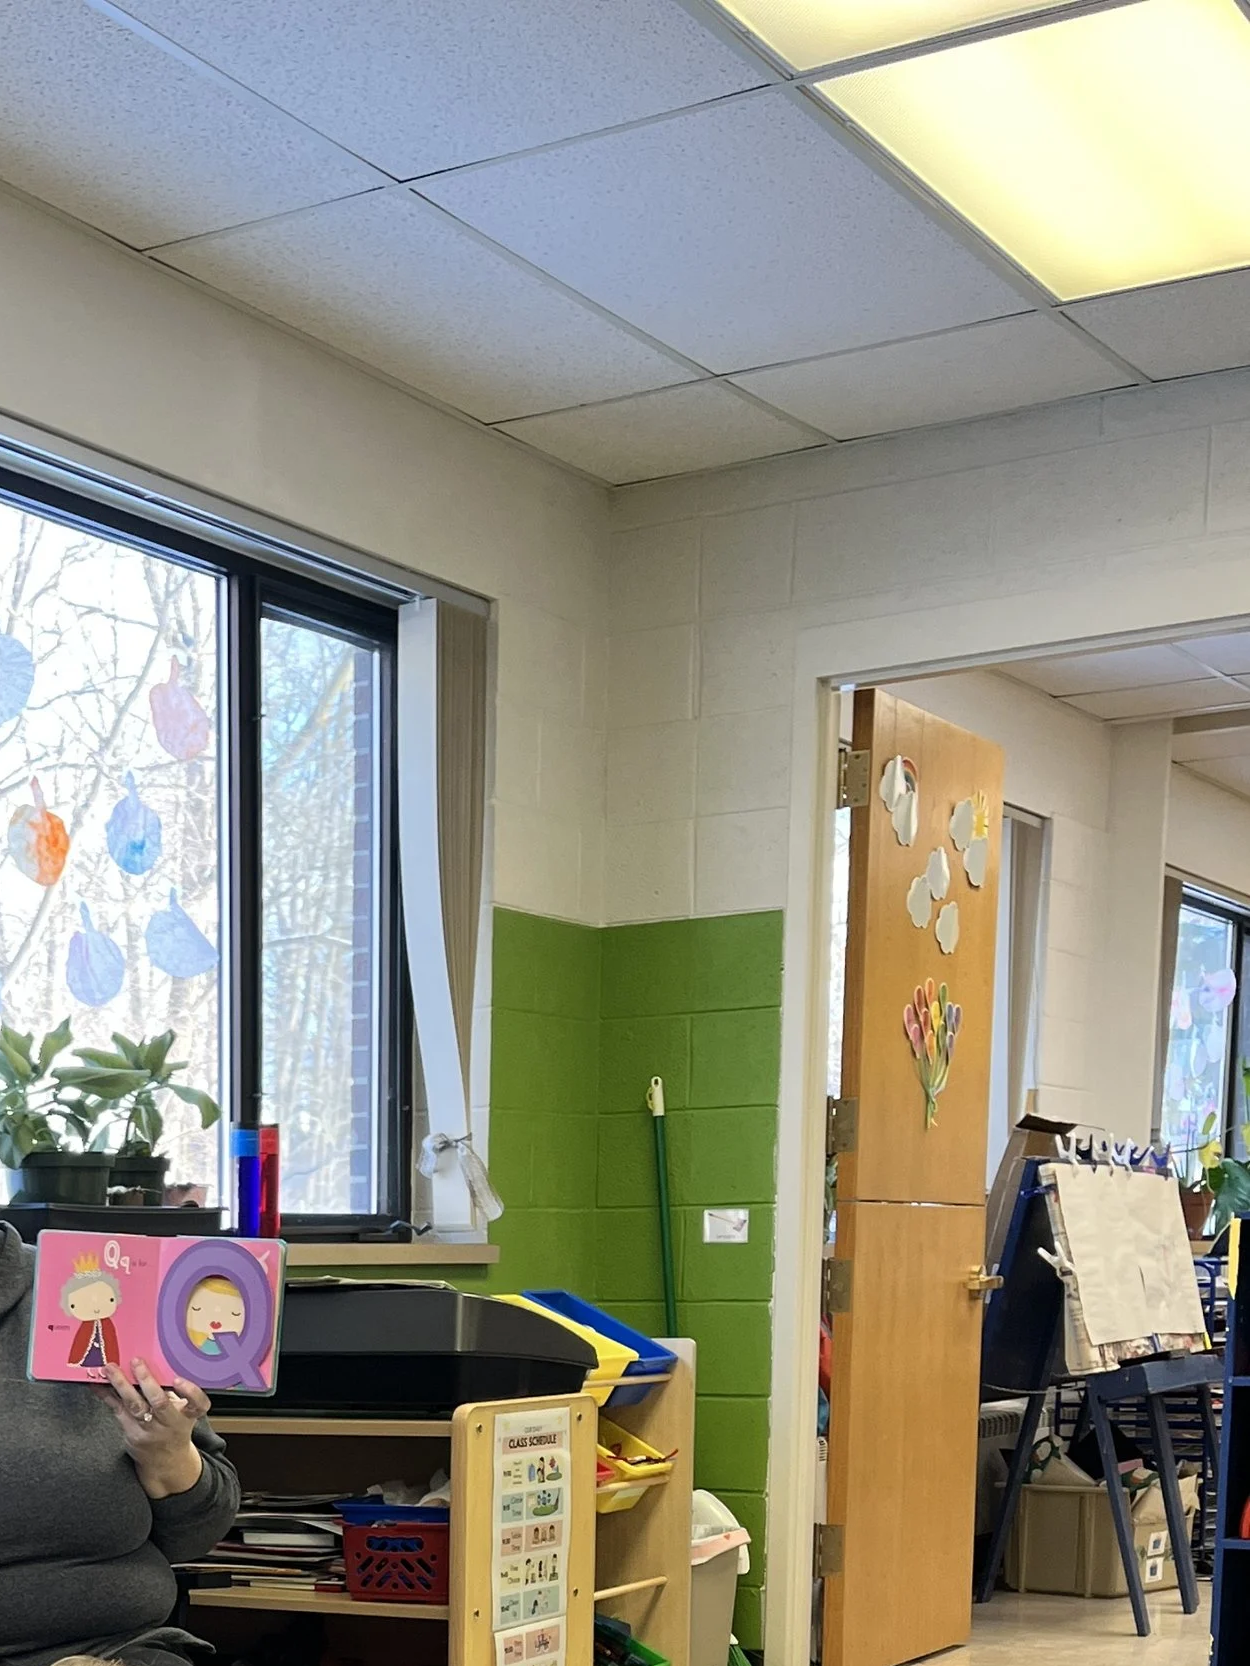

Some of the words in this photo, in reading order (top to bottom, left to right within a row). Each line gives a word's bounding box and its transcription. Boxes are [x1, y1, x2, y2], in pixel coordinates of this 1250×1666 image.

[104, 1240, 131, 1274] Qq
[157, 1239, 272, 1390] Q
[508, 1436, 528, 1449] CLASS
[528, 1433, 557, 1447] SCHEDULE
